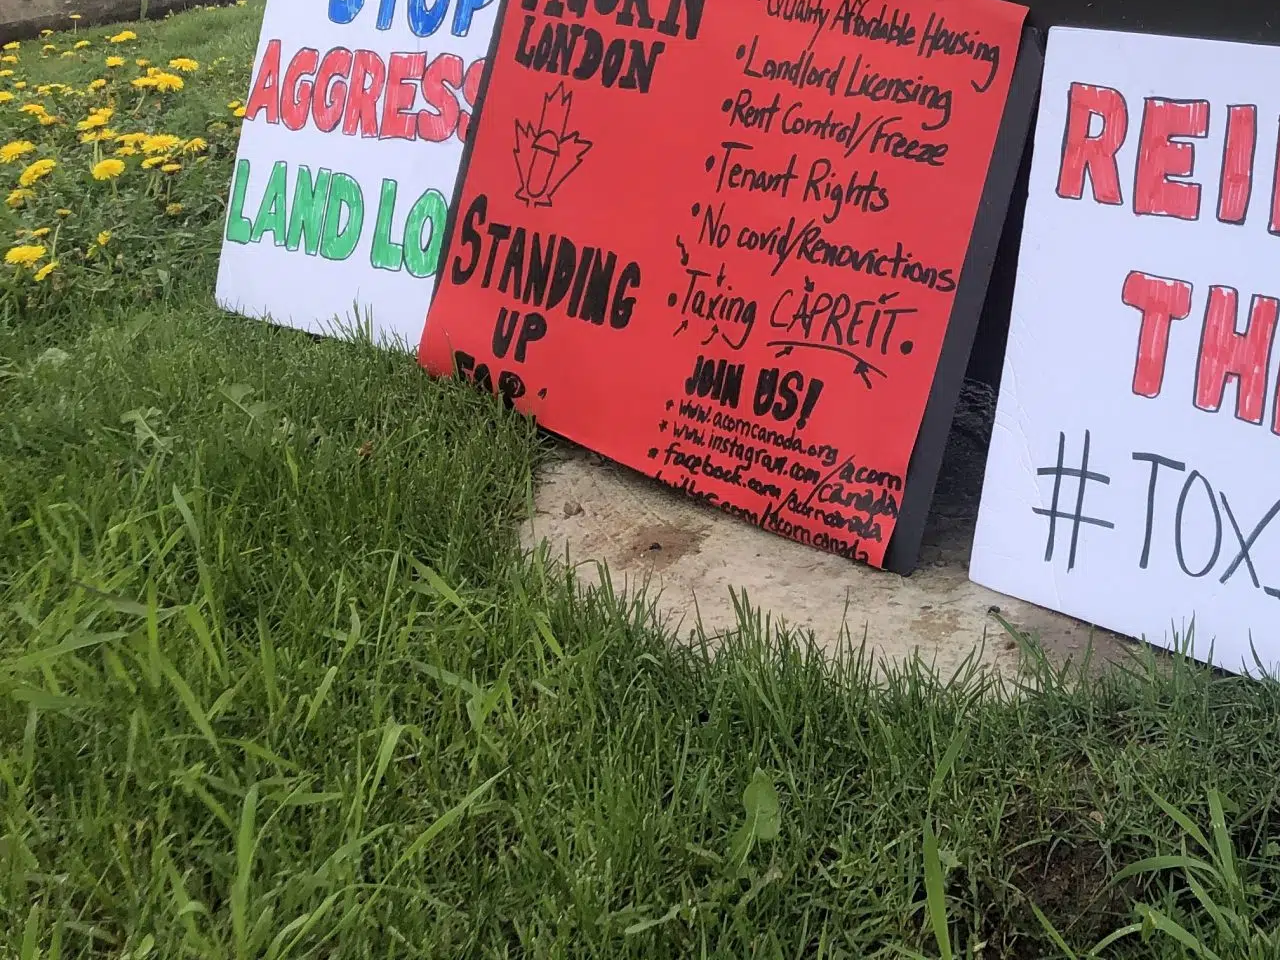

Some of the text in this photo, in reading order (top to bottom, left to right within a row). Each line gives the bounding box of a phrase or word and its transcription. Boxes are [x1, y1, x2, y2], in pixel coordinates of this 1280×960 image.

[514, 14, 666, 94] LONDON
[743, 34, 953, 131] Landlord Licensing
[916, 11, 1001, 93] Housing
[729, 88, 781, 134] Rent
[716, 141, 889, 224] Tenant Rights
[451, 194, 641, 329] STANDING
[698, 202, 732, 249] No
[492, 306, 548, 363] UP
[681, 268, 758, 351] Taxing
[684, 355, 825, 430] JOIN US!
